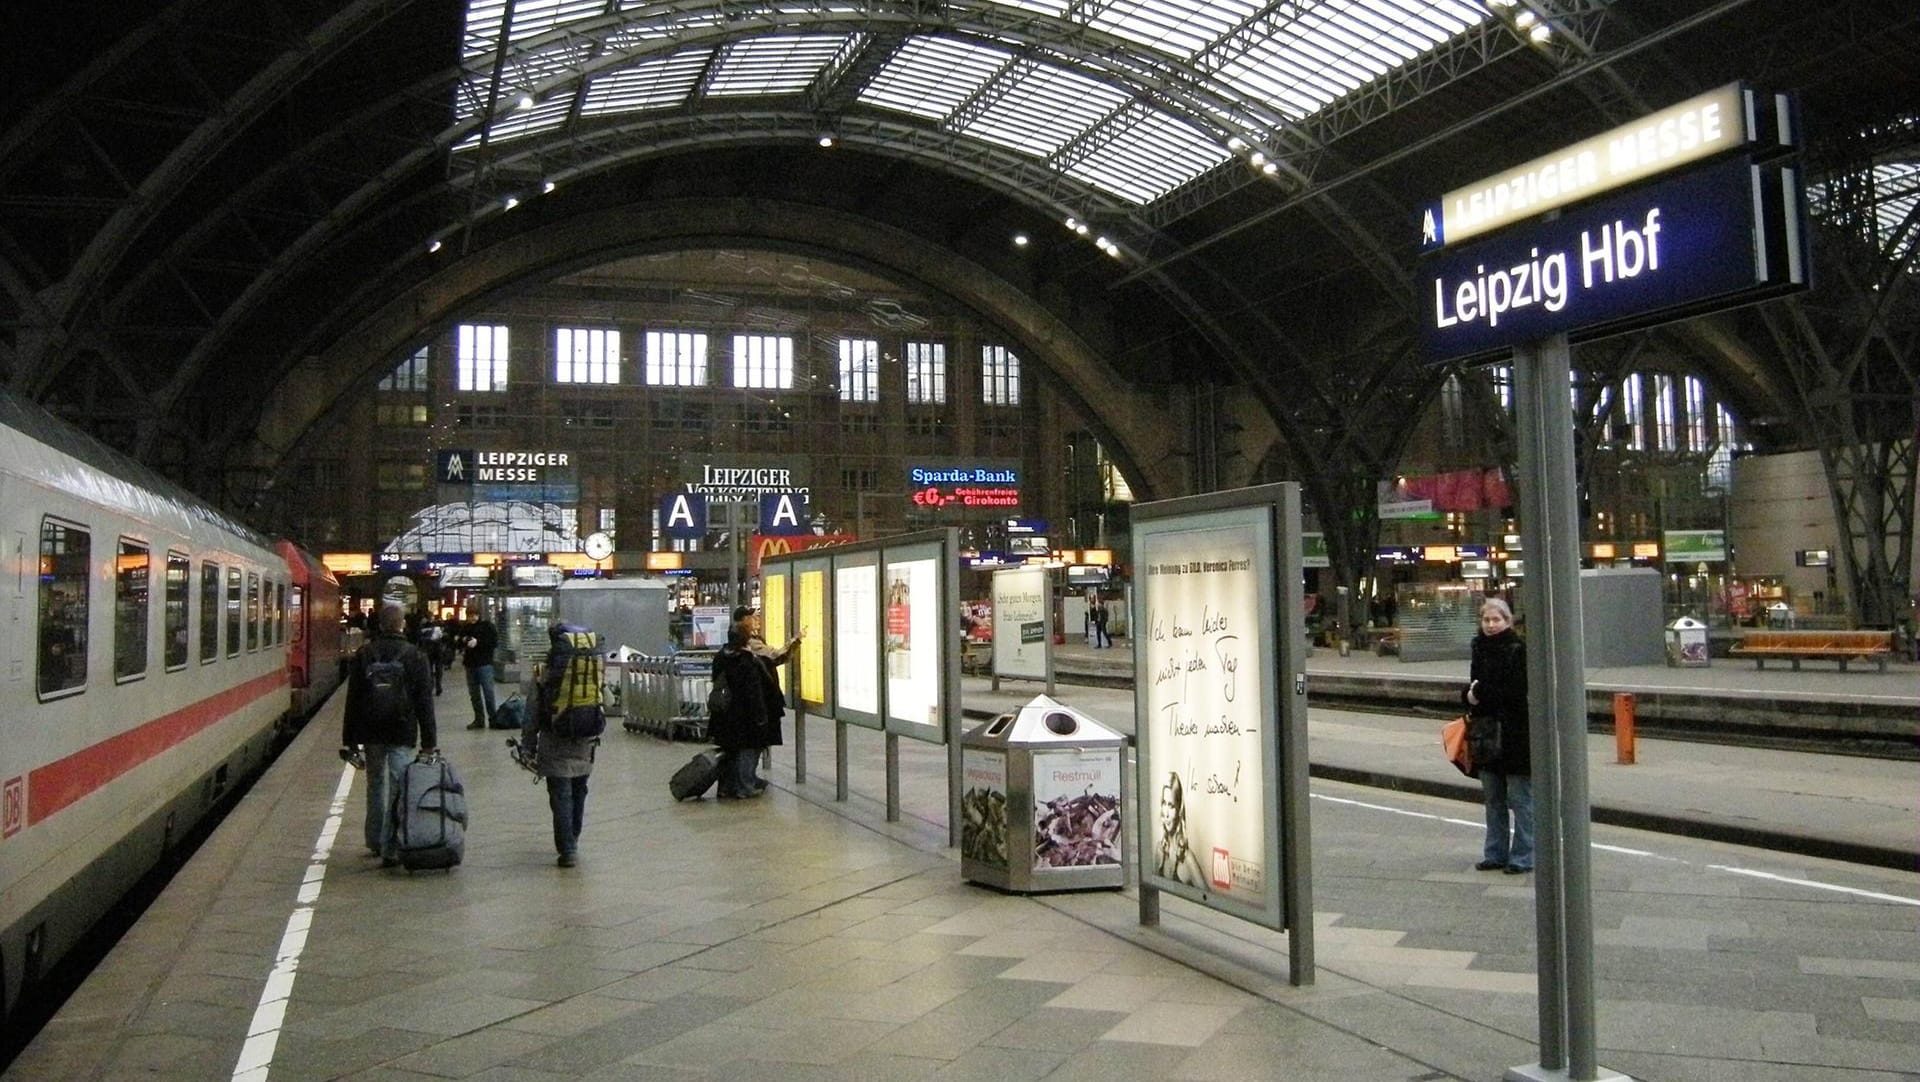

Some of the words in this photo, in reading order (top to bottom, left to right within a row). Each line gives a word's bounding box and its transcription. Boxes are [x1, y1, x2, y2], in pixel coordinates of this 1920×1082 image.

[1455, 151, 1598, 229] LEIPZIGER
[1608, 103, 1721, 176] MESSE
[1435, 248, 1567, 328] Leipzig
[1581, 208, 1661, 289] Hbf
[479, 452, 568, 466] LEIPZIGER
[480, 468, 537, 481] MESSE
[703, 464, 791, 486] LEIPZIGER
[912, 468, 1016, 485] Sparda-Bank
[963, 495, 1018, 506] Girokonto
[667, 494, 695, 528] A
[772, 494, 798, 527] A
[1052, 770, 1102, 784] Restmüll
